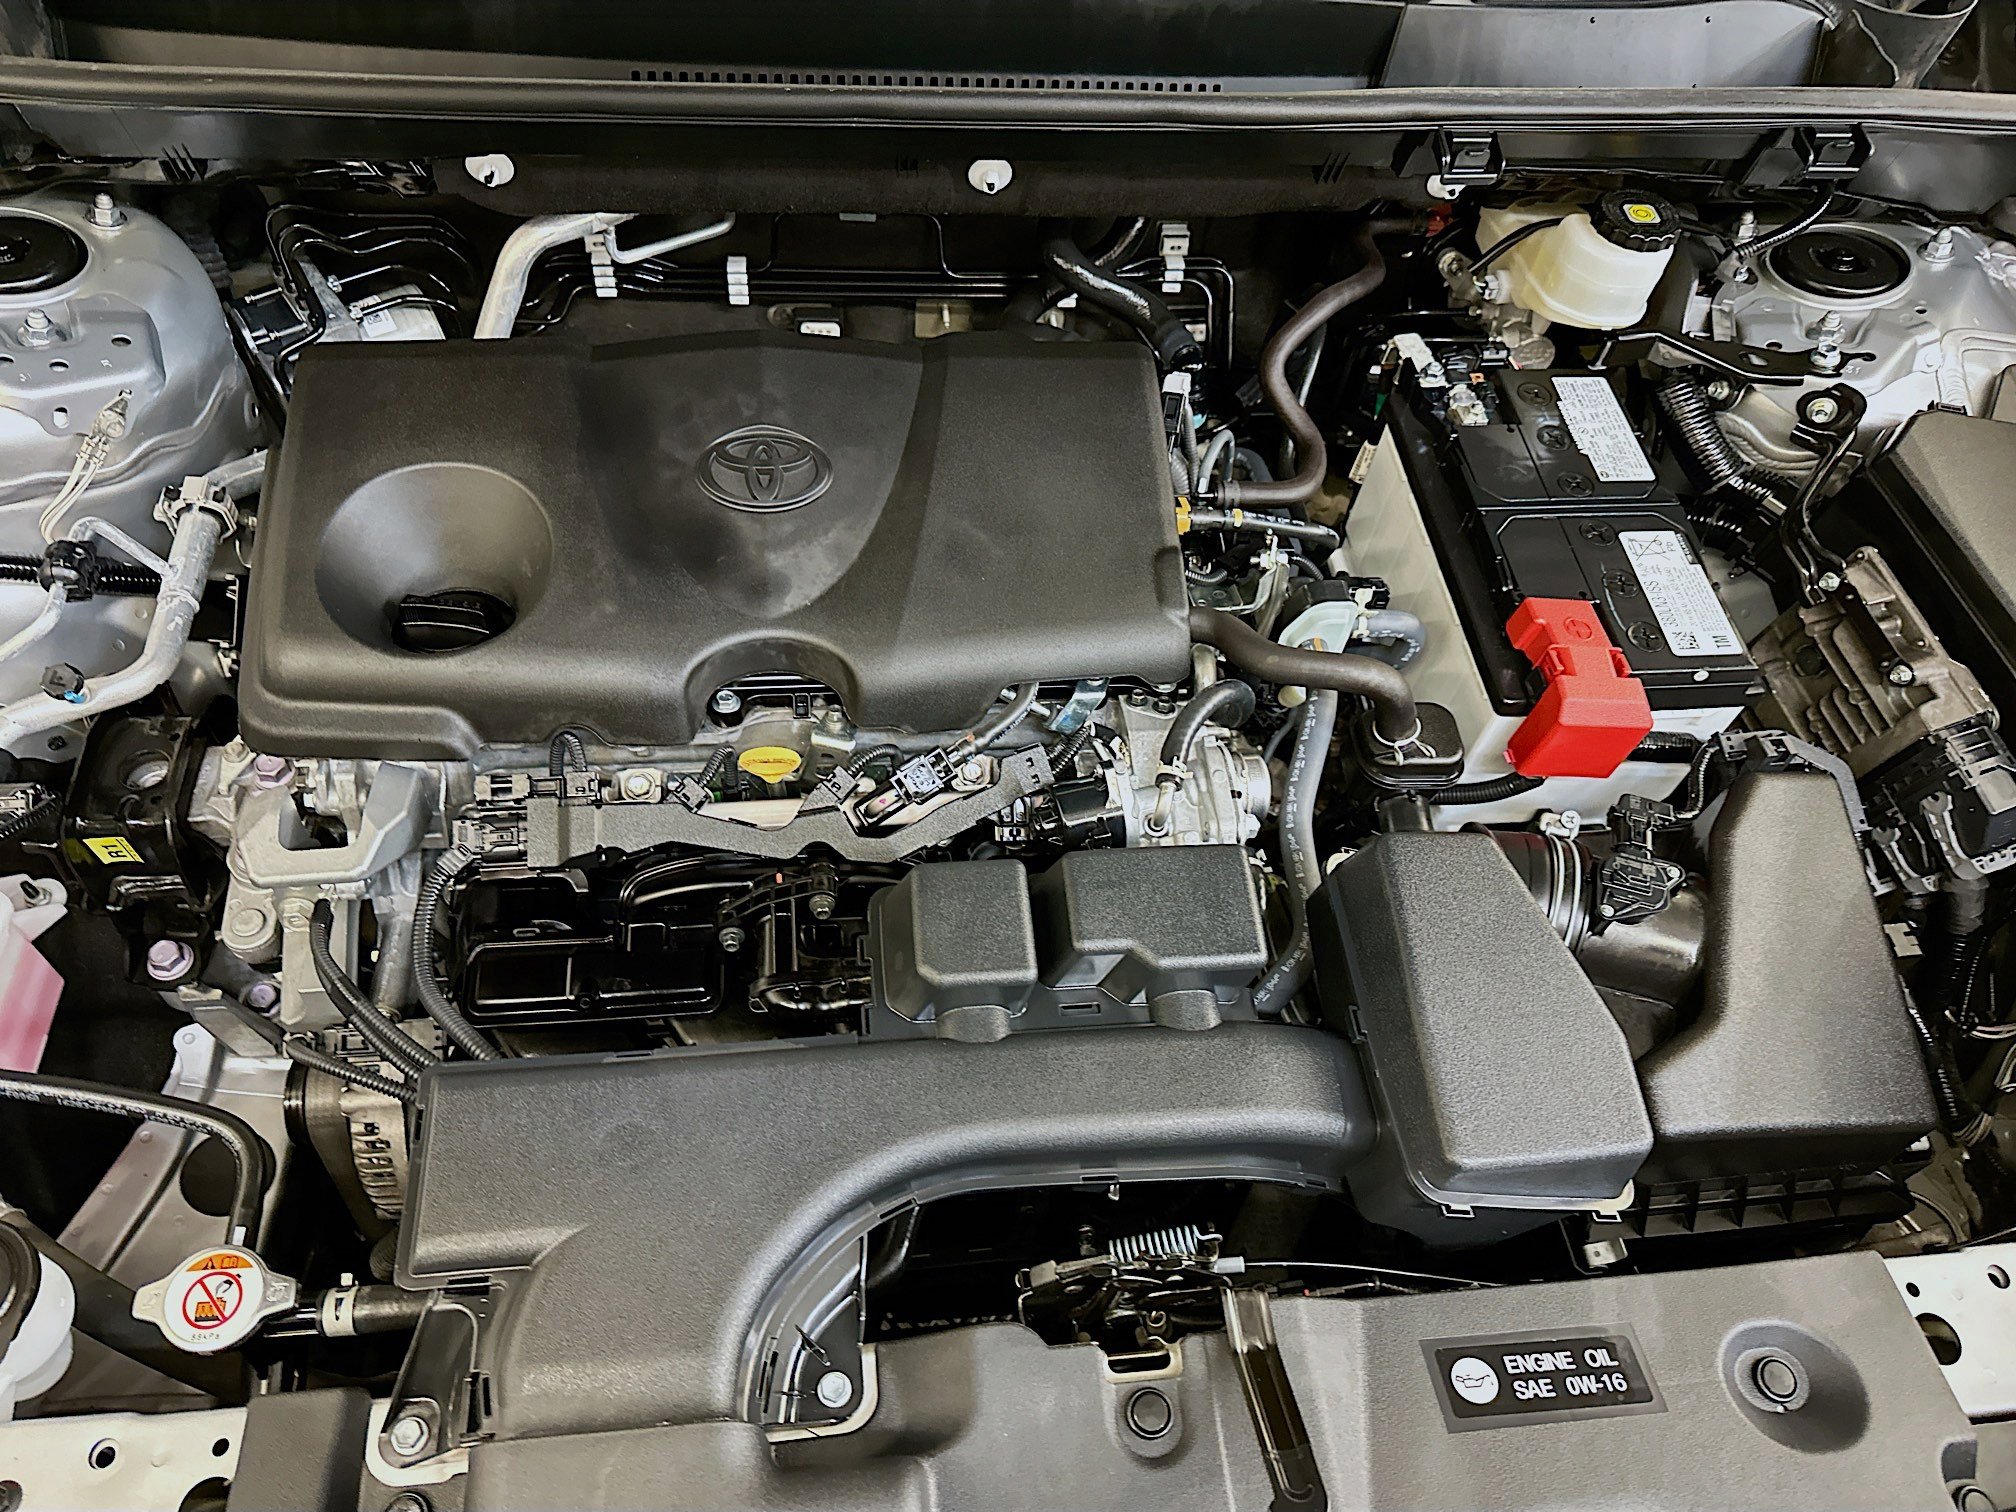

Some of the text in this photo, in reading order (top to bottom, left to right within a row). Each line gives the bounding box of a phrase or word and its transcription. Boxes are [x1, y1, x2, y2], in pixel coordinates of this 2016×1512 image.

[1711, 635, 1732, 649] TM
[102, 844, 127, 858] R1
[1503, 1348, 1619, 1374] ENGINE OIL
[1513, 1373, 1628, 1399] SAE 0W-16
